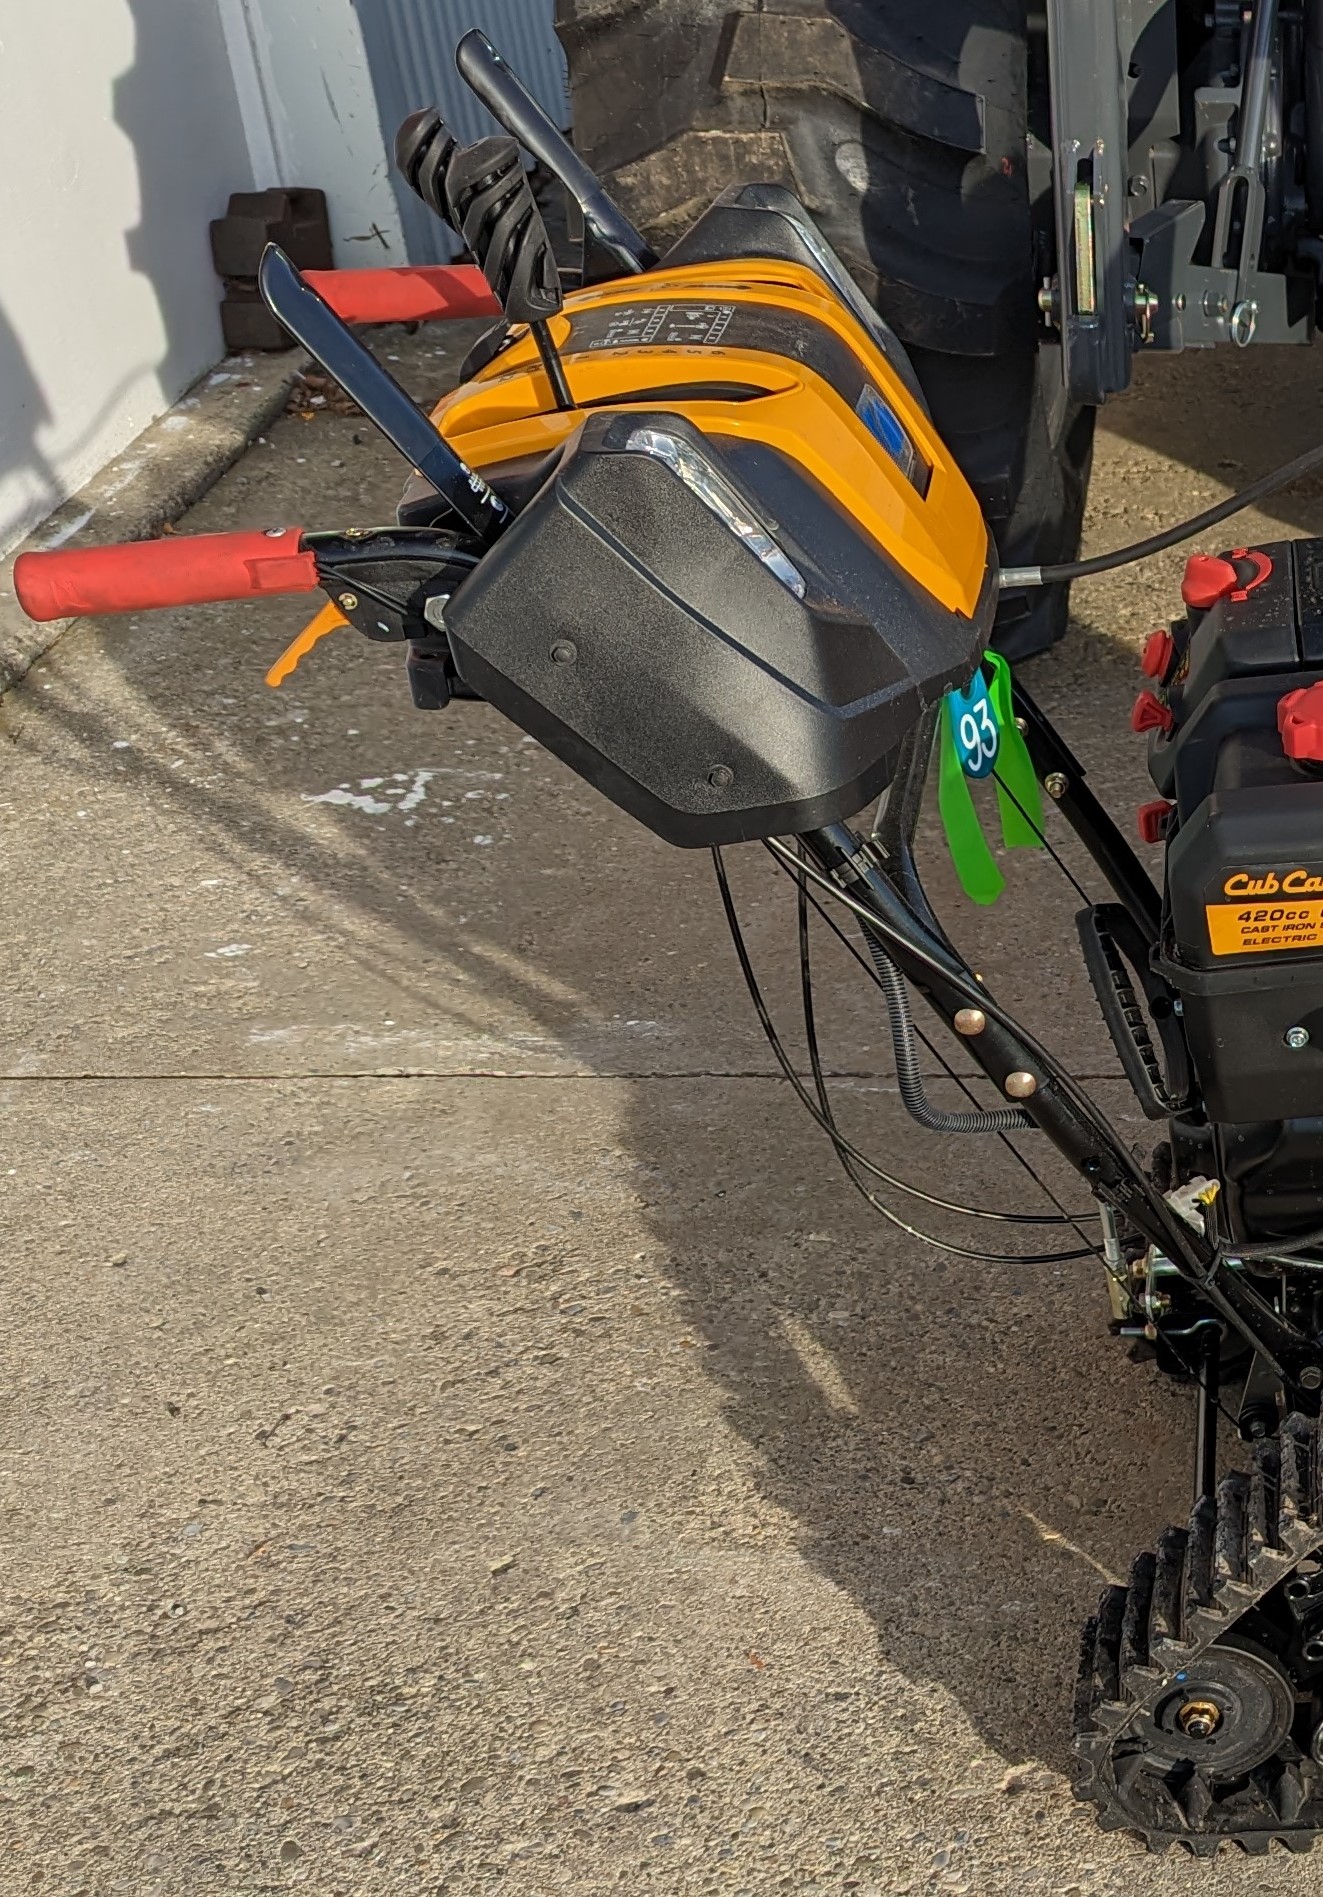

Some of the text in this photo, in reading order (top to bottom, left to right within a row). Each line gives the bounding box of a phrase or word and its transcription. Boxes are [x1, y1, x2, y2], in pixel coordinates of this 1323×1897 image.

[960, 698, 996, 771] 93
[1224, 868, 1278, 897] Cub
[1237, 908, 1310, 922] 420cc
[1240, 924, 1280, 935] CAST
[1282, 922, 1316, 932] IRON
[1242, 933, 1318, 946] ELECTRIC
